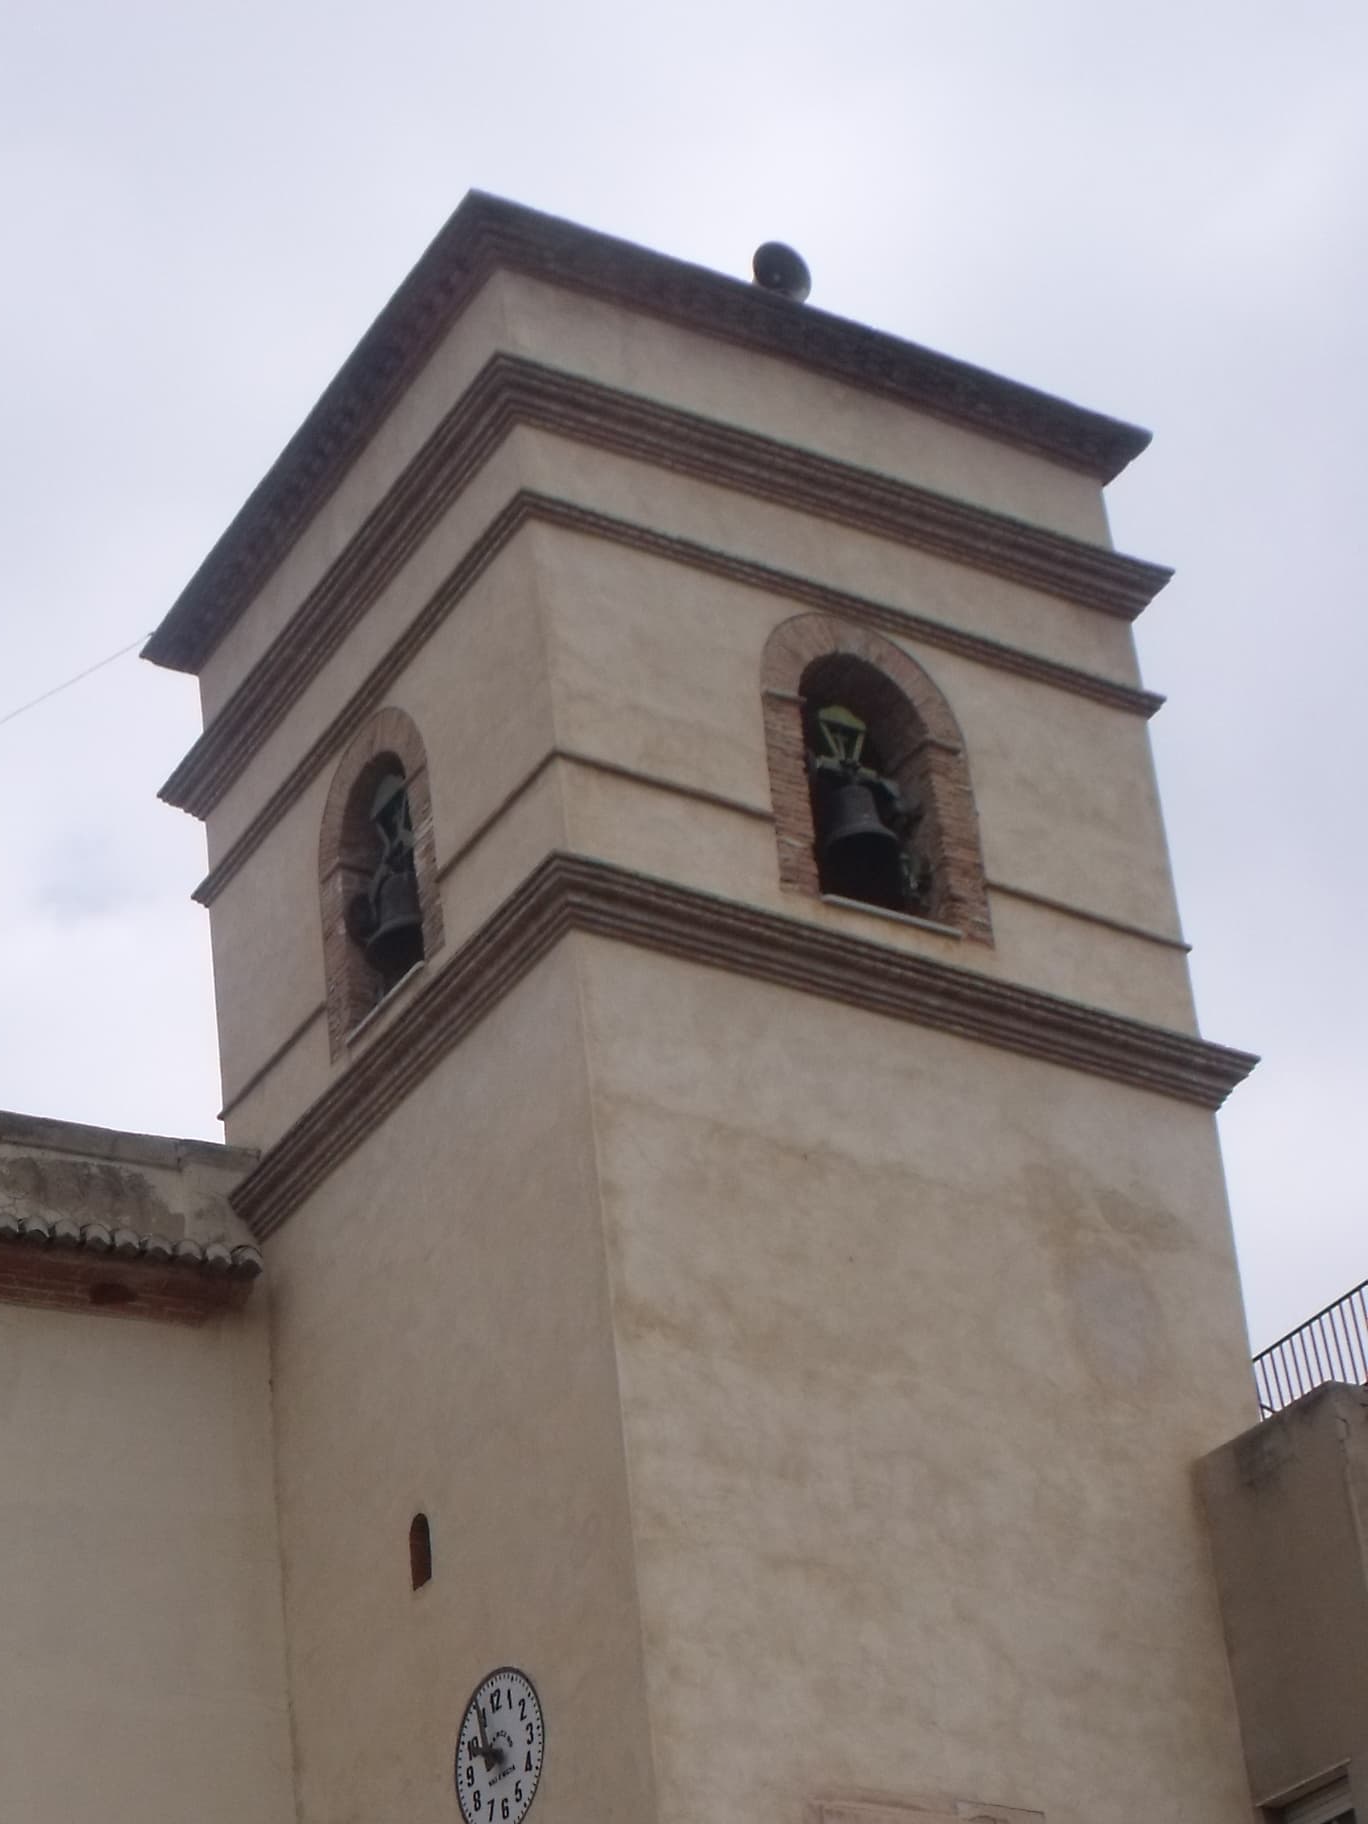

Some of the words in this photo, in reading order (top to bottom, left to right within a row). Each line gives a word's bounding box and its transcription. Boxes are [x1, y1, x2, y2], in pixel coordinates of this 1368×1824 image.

[490, 1689, 501, 1713] 12
[507, 1689, 512, 1710] 1
[518, 1698, 527, 1721] 2
[525, 1722, 534, 1745] 3
[467, 1736, 480, 1761] 10
[525, 1749, 533, 1772] 4
[466, 1765, 475, 1788] 9
[473, 1790, 482, 1812] 8
[514, 1780, 523, 1803] 5
[487, 1798, 495, 1822] 7
[501, 1798, 510, 1820] 6
